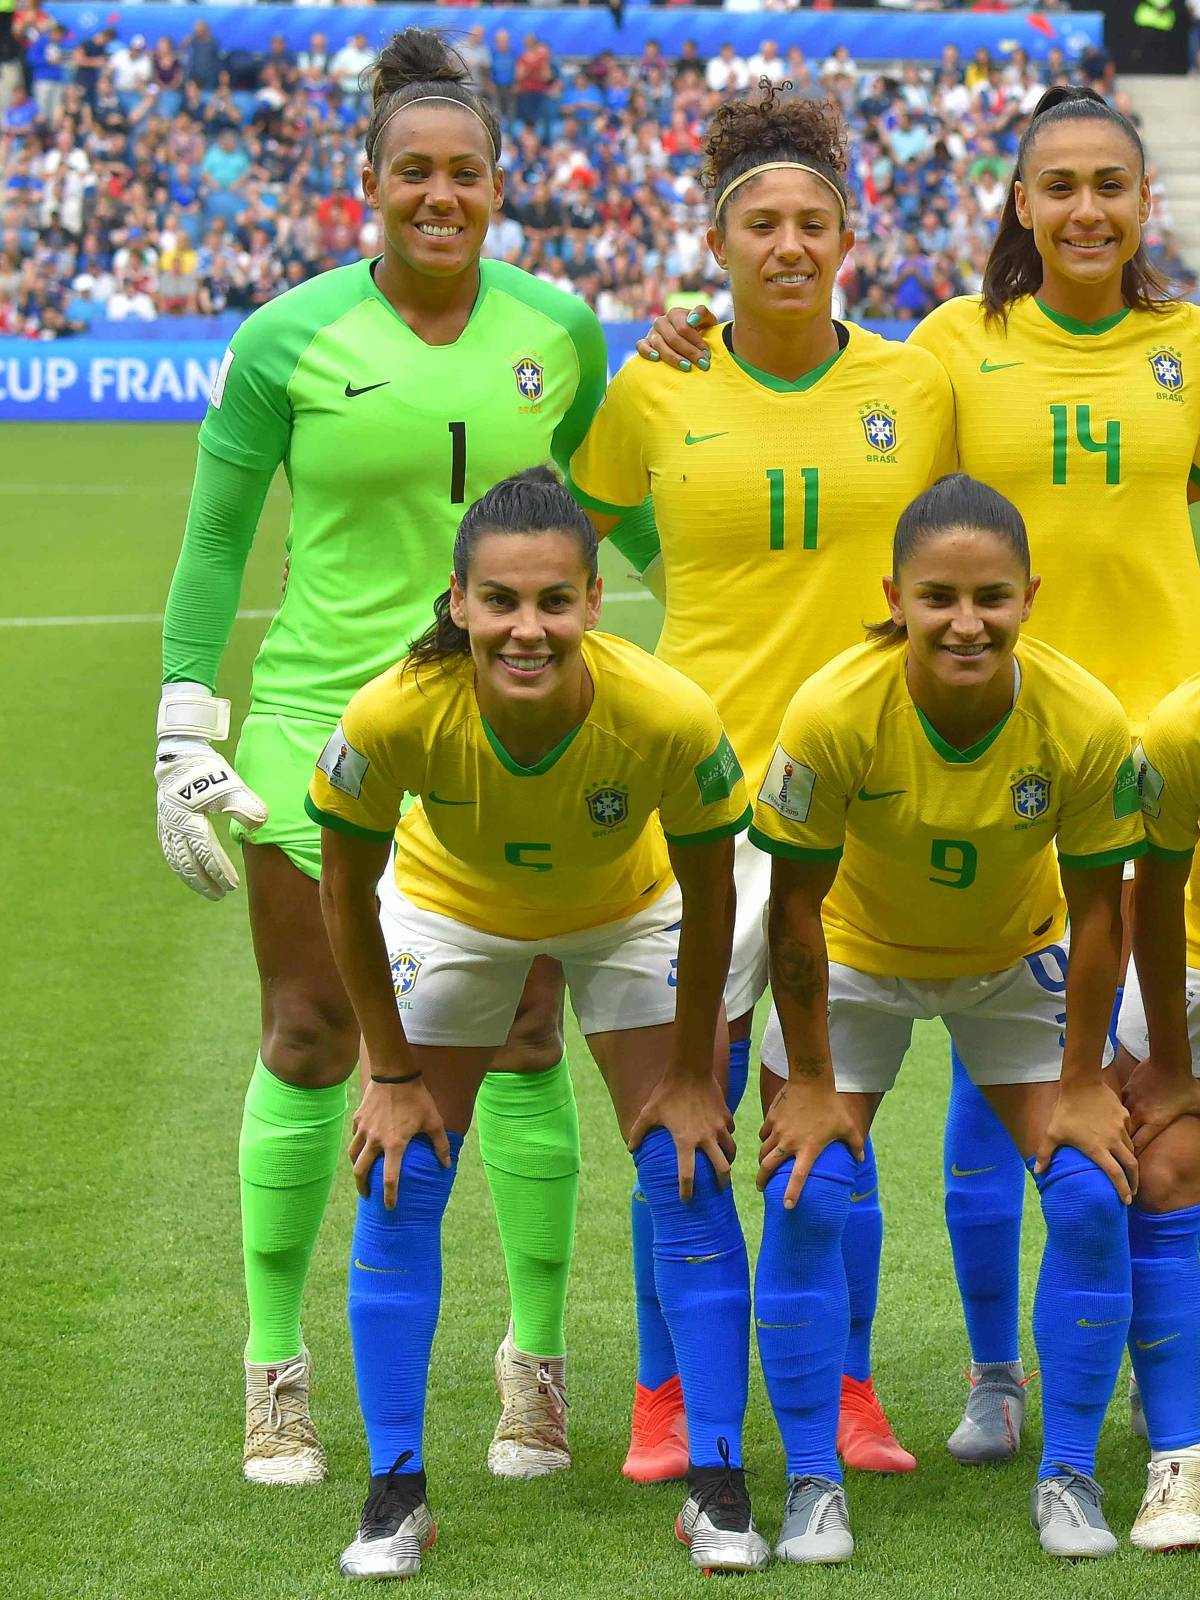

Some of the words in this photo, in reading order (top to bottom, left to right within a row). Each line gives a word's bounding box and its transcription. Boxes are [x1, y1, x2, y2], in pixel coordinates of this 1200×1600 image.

[1156, 392, 1185, 403] BRASIL
[448, 421, 466, 504] 1
[866, 454, 898, 464] BRASIL
[1050, 405, 1120, 485] 14
[766, 467, 819, 550] 11
[929, 838, 978, 890] 9
